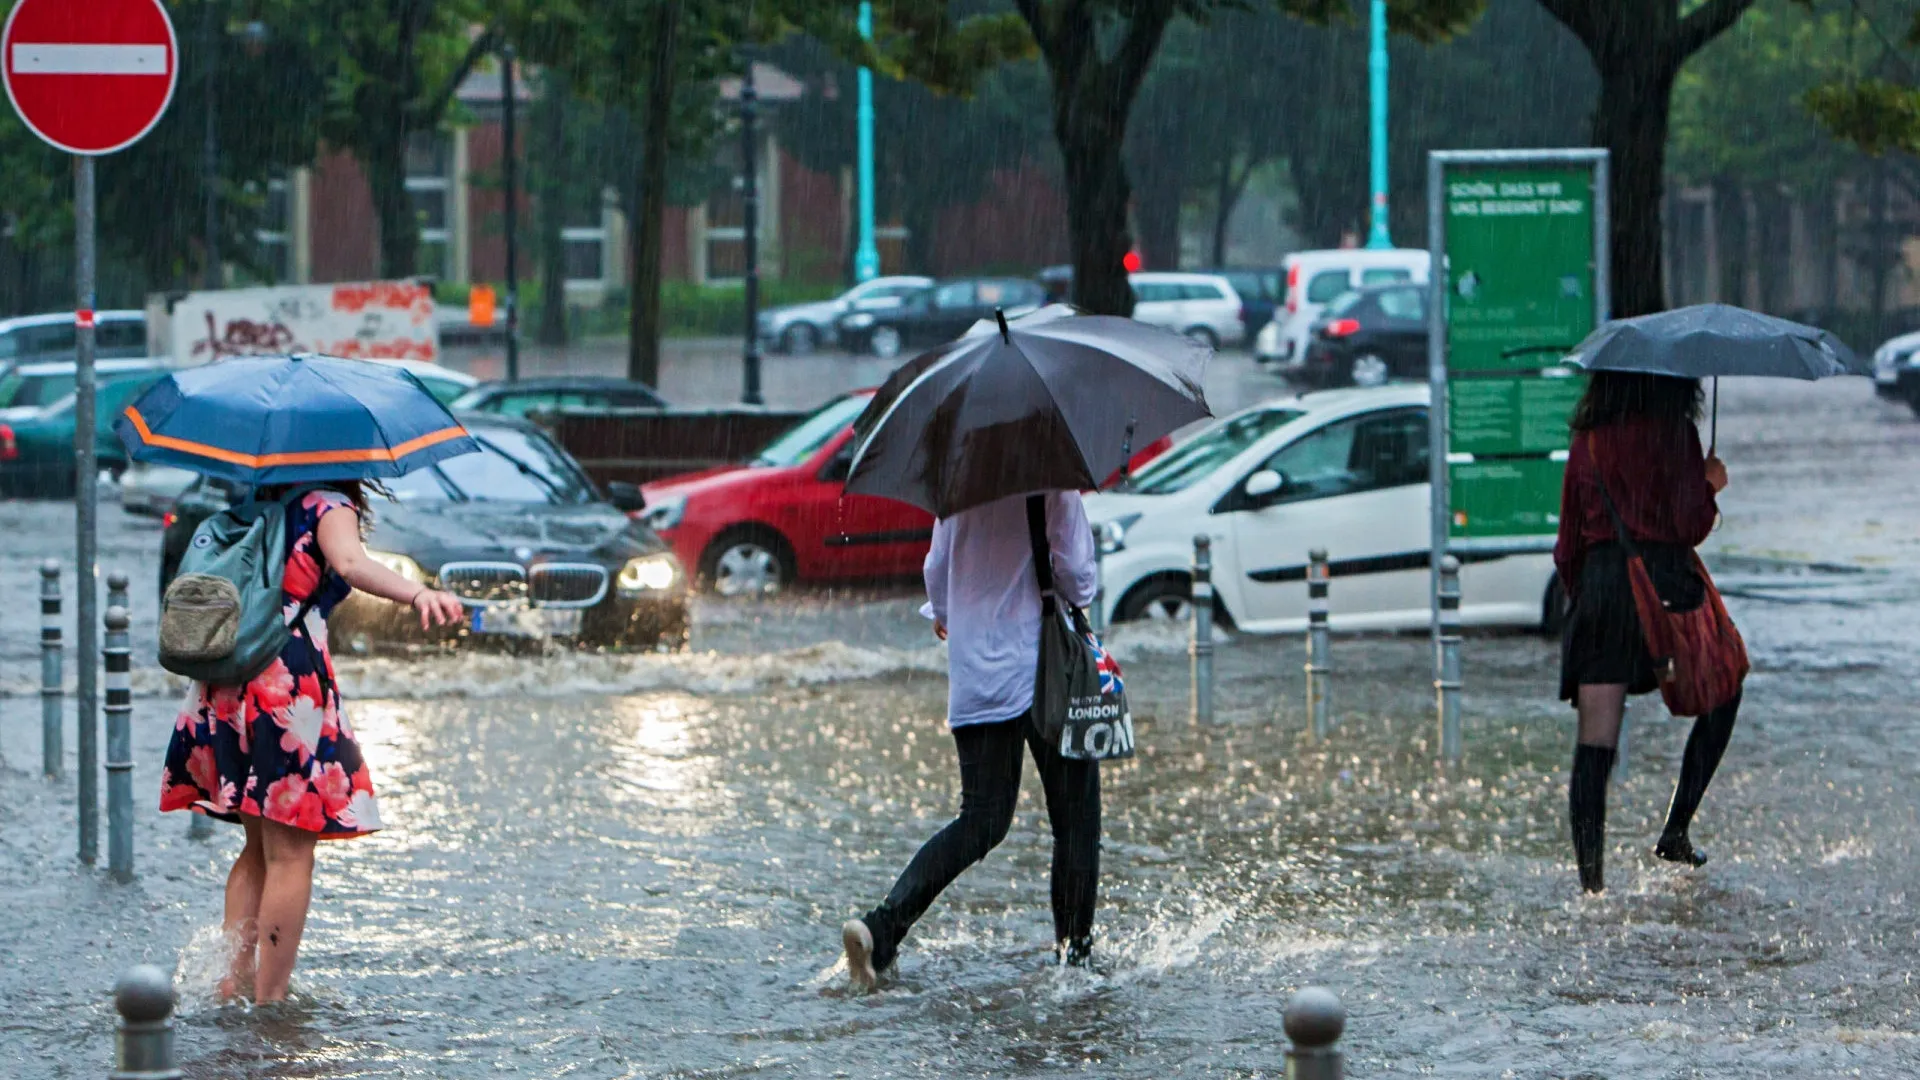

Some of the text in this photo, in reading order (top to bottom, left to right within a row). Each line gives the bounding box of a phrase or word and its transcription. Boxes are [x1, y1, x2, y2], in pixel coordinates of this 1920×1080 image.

[1501, 183, 1534, 197] DASS
[1537, 182, 1561, 196] WIR
[1450, 201, 1478, 215] UNS
[1068, 704, 1119, 719] LONDON
